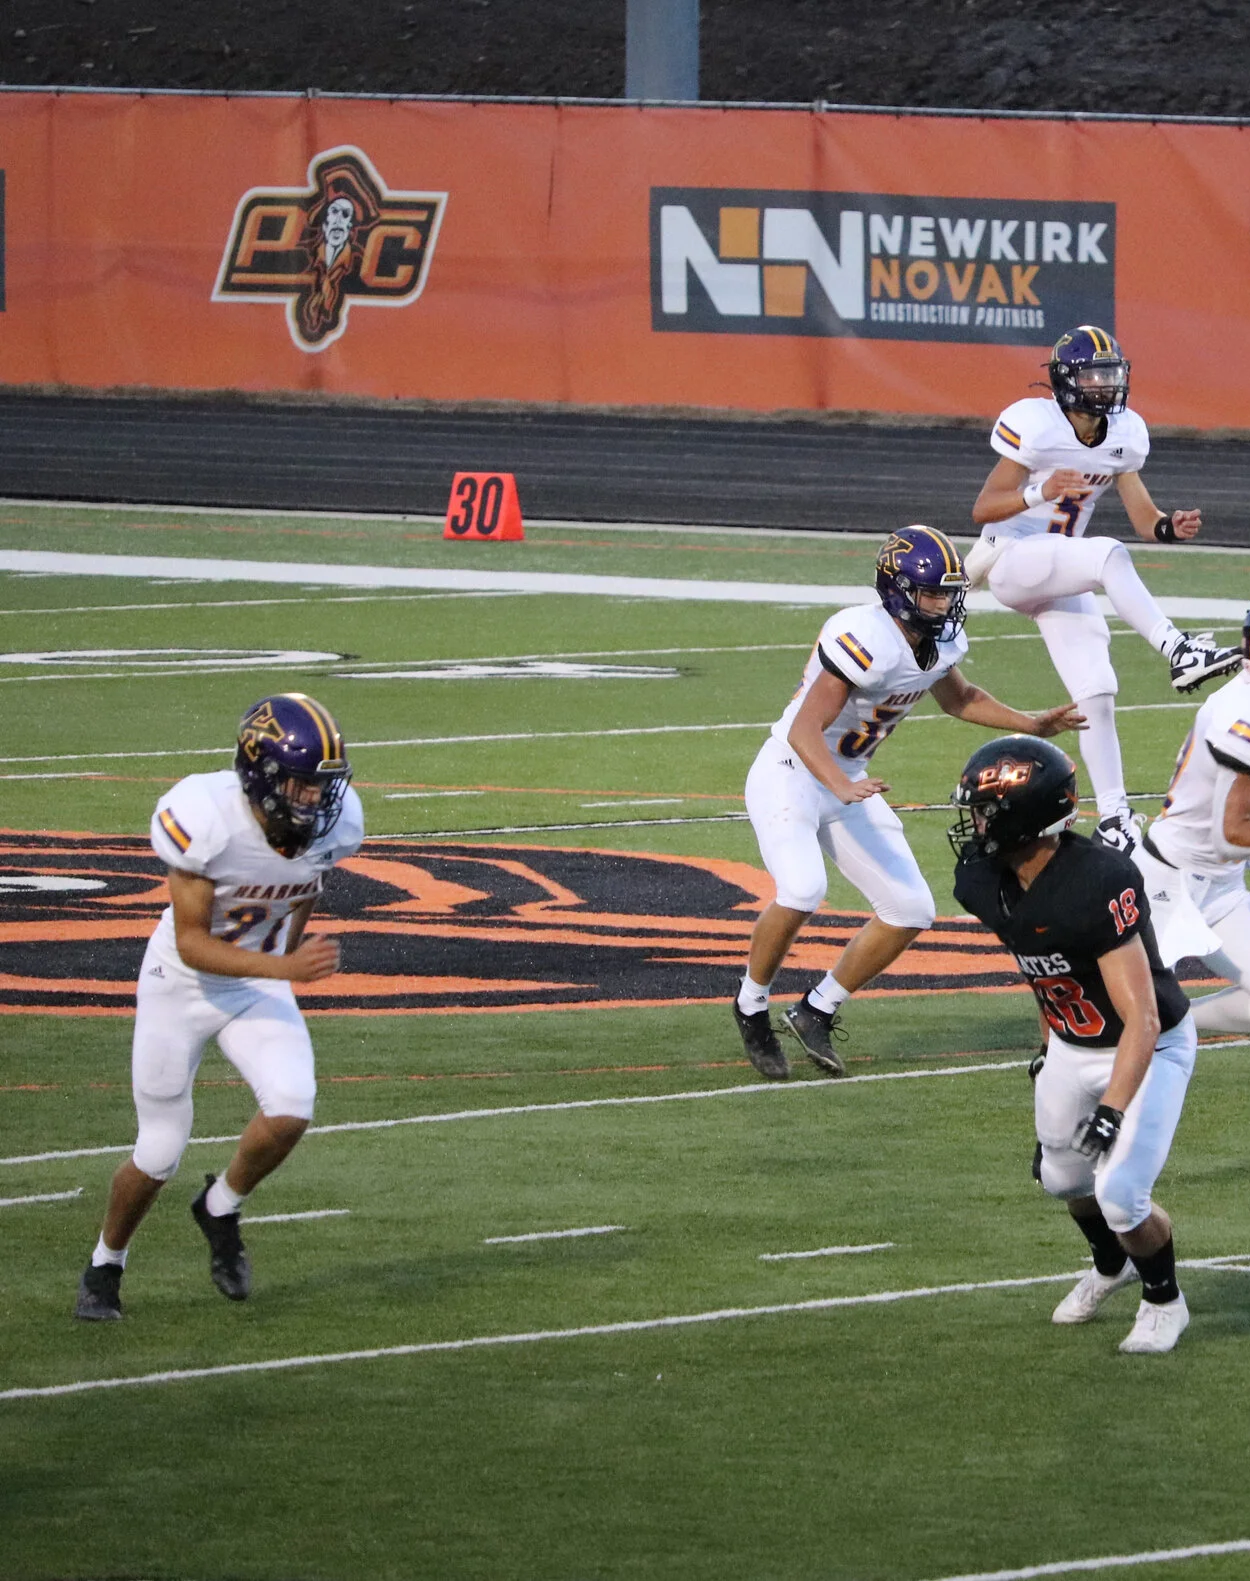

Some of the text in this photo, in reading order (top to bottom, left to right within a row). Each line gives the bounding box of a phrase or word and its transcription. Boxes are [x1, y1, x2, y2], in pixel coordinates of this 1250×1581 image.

[869, 213, 1109, 264] NEWKIRK
[870, 257, 1041, 306] NOVAK
[870, 302, 1045, 329] CONSTRUCTION PARTNERS
[450, 476, 504, 535] 30
[1109, 887, 1140, 936] 18
